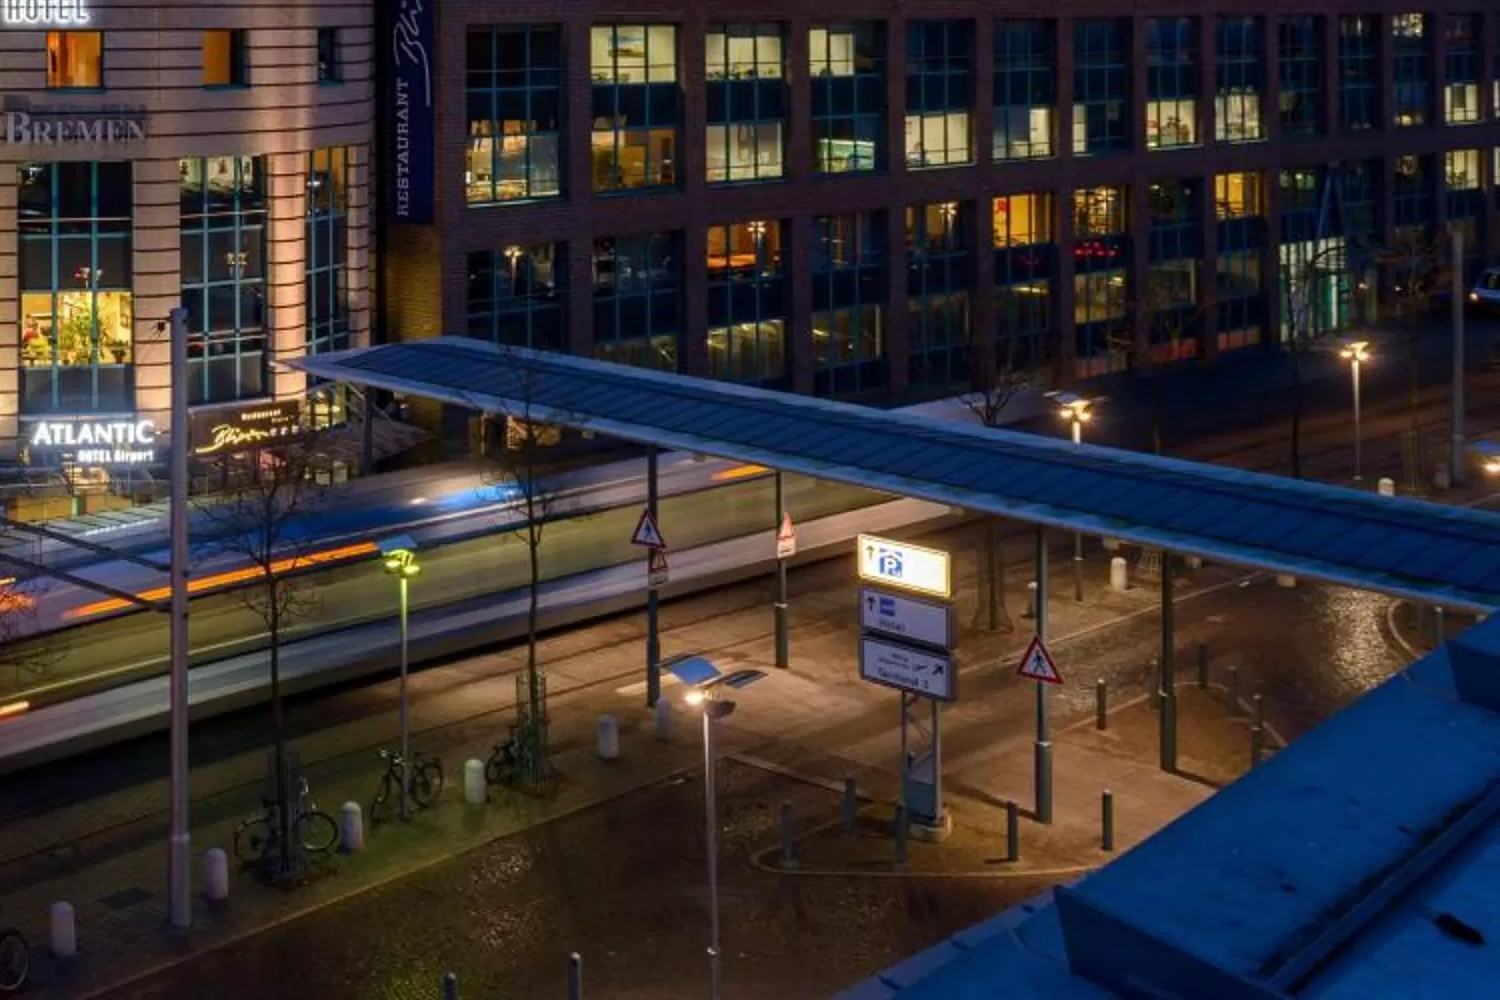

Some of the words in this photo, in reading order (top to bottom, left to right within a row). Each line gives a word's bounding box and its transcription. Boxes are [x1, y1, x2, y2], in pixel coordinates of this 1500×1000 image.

[397, 78, 409, 216] RESTAURANT
[31, 420, 154, 445] ATLANTIC
[77, 449, 112, 462] HOTEL
[113, 449, 154, 464] Airport
